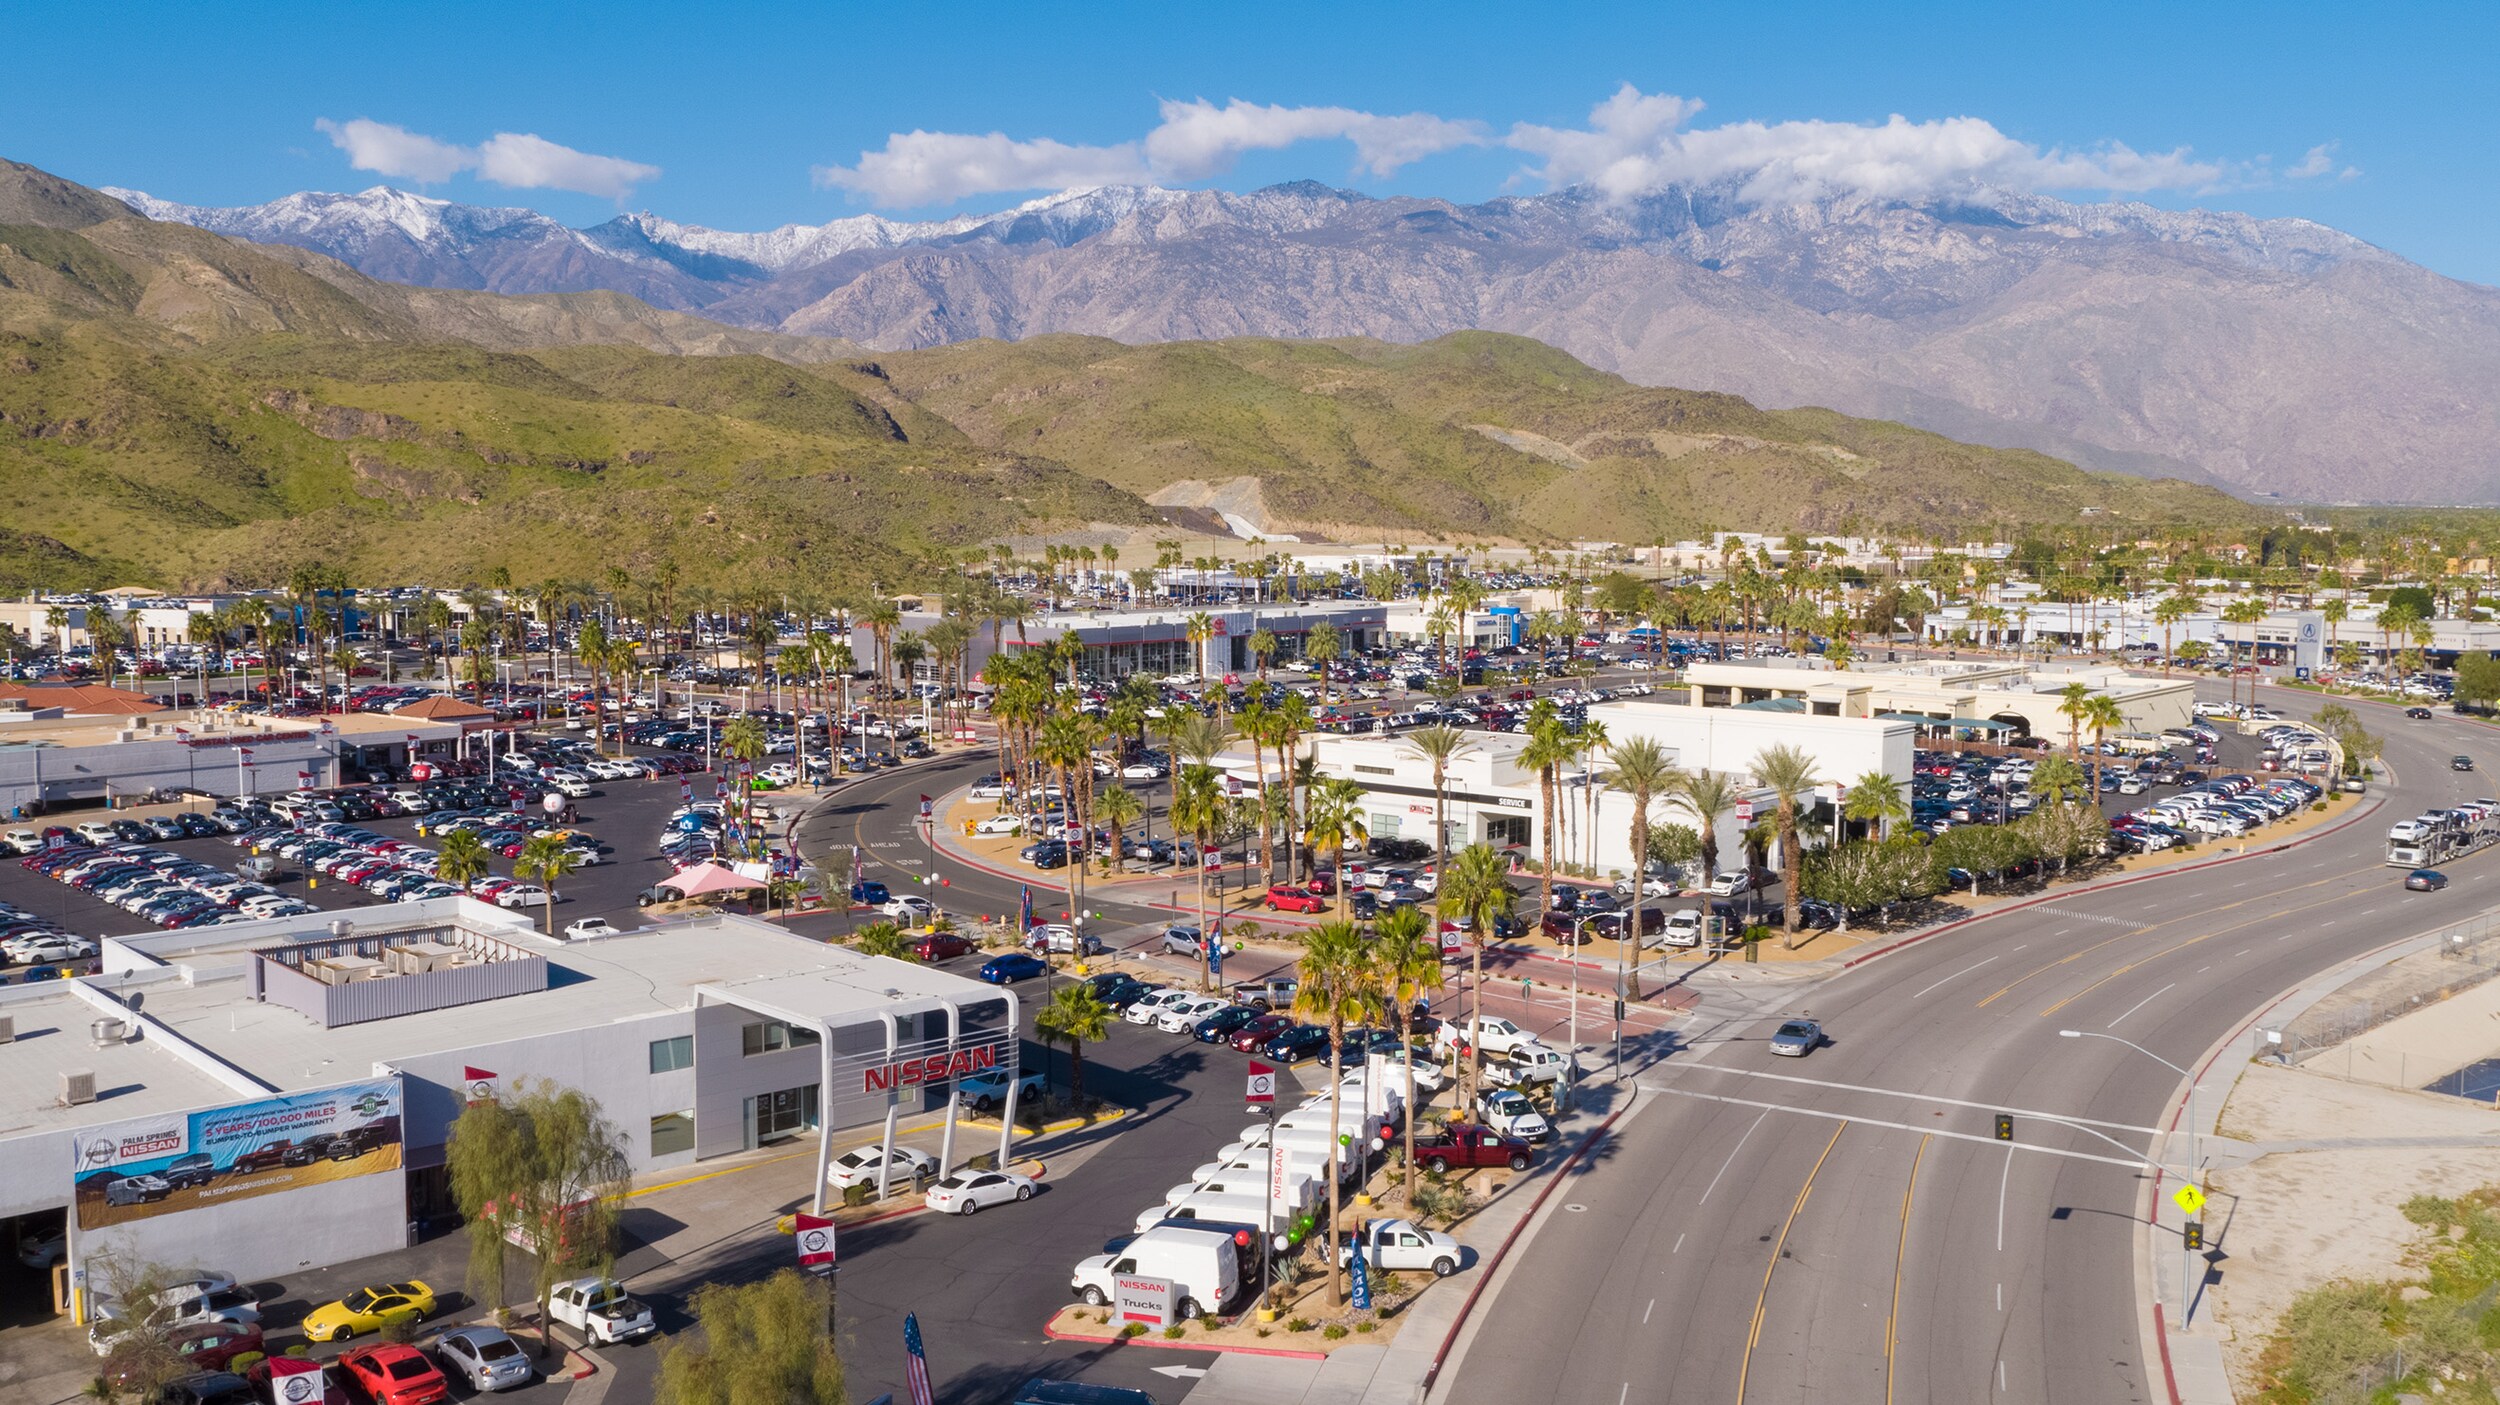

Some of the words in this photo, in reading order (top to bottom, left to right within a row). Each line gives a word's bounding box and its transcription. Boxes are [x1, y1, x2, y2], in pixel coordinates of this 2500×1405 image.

[189, 737, 227, 748] CRYSTAL
[256, 733, 274, 743] CAR
[275, 730, 310, 742] CENTER
[1498, 797, 1526, 808] SERVICE
[863, 1044, 996, 1093] NISSAN
[206, 1128, 213, 1137] 5
[215, 1112, 302, 1135] YEARS/100,000
[304, 1106, 337, 1119] MILES
[206, 1125, 290, 1145] BUMPER-TO-BUMPER
[291, 1116, 335, 1130] WARRANTY
[122, 1135, 144, 1145] PALM
[146, 1130, 177, 1141] SPRINGS
[122, 1138, 178, 1156] NISSAN
[1273, 1148, 1284, 1199] NISSAN
[1119, 1280, 1165, 1293] NISSAN
[1122, 1298, 1163, 1311] Trucks
